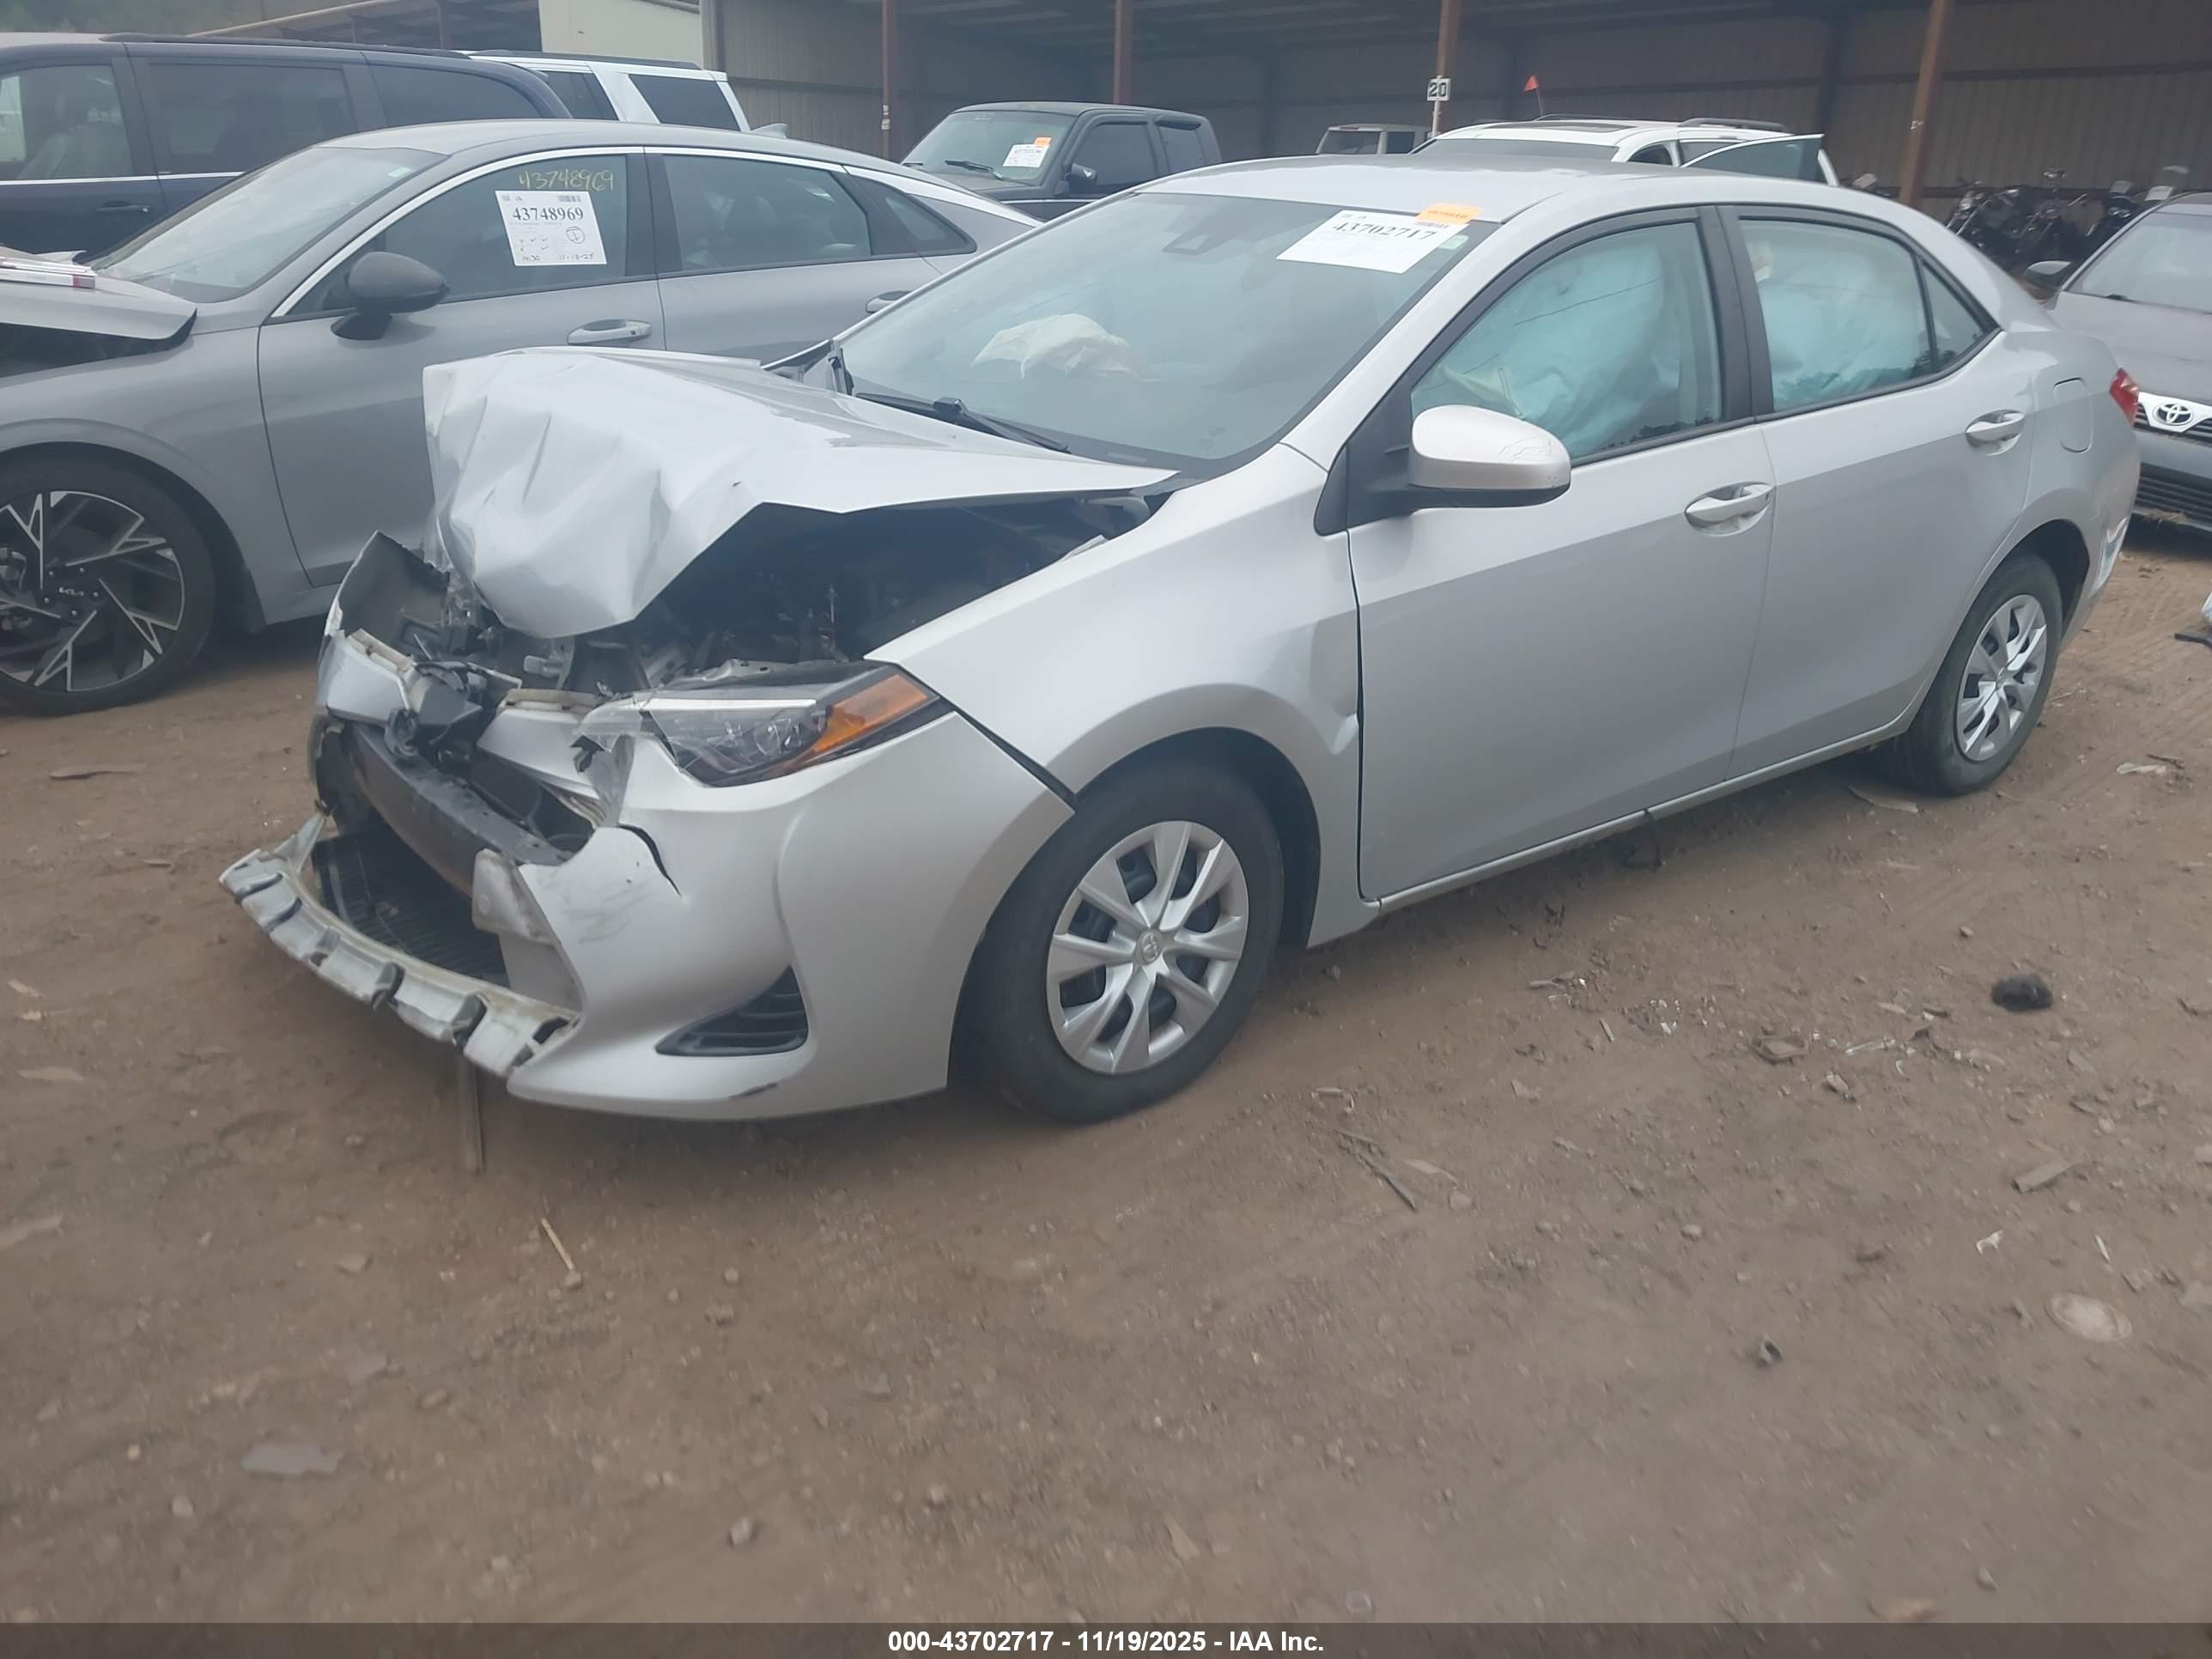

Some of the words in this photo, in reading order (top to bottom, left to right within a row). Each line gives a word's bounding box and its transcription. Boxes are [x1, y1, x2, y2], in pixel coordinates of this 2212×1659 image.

[1429, 82, 1447, 97] 20
[518, 168, 614, 191] 43748969
[513, 207, 584, 221] 43748969
[1332, 222, 1438, 240] 43702717
